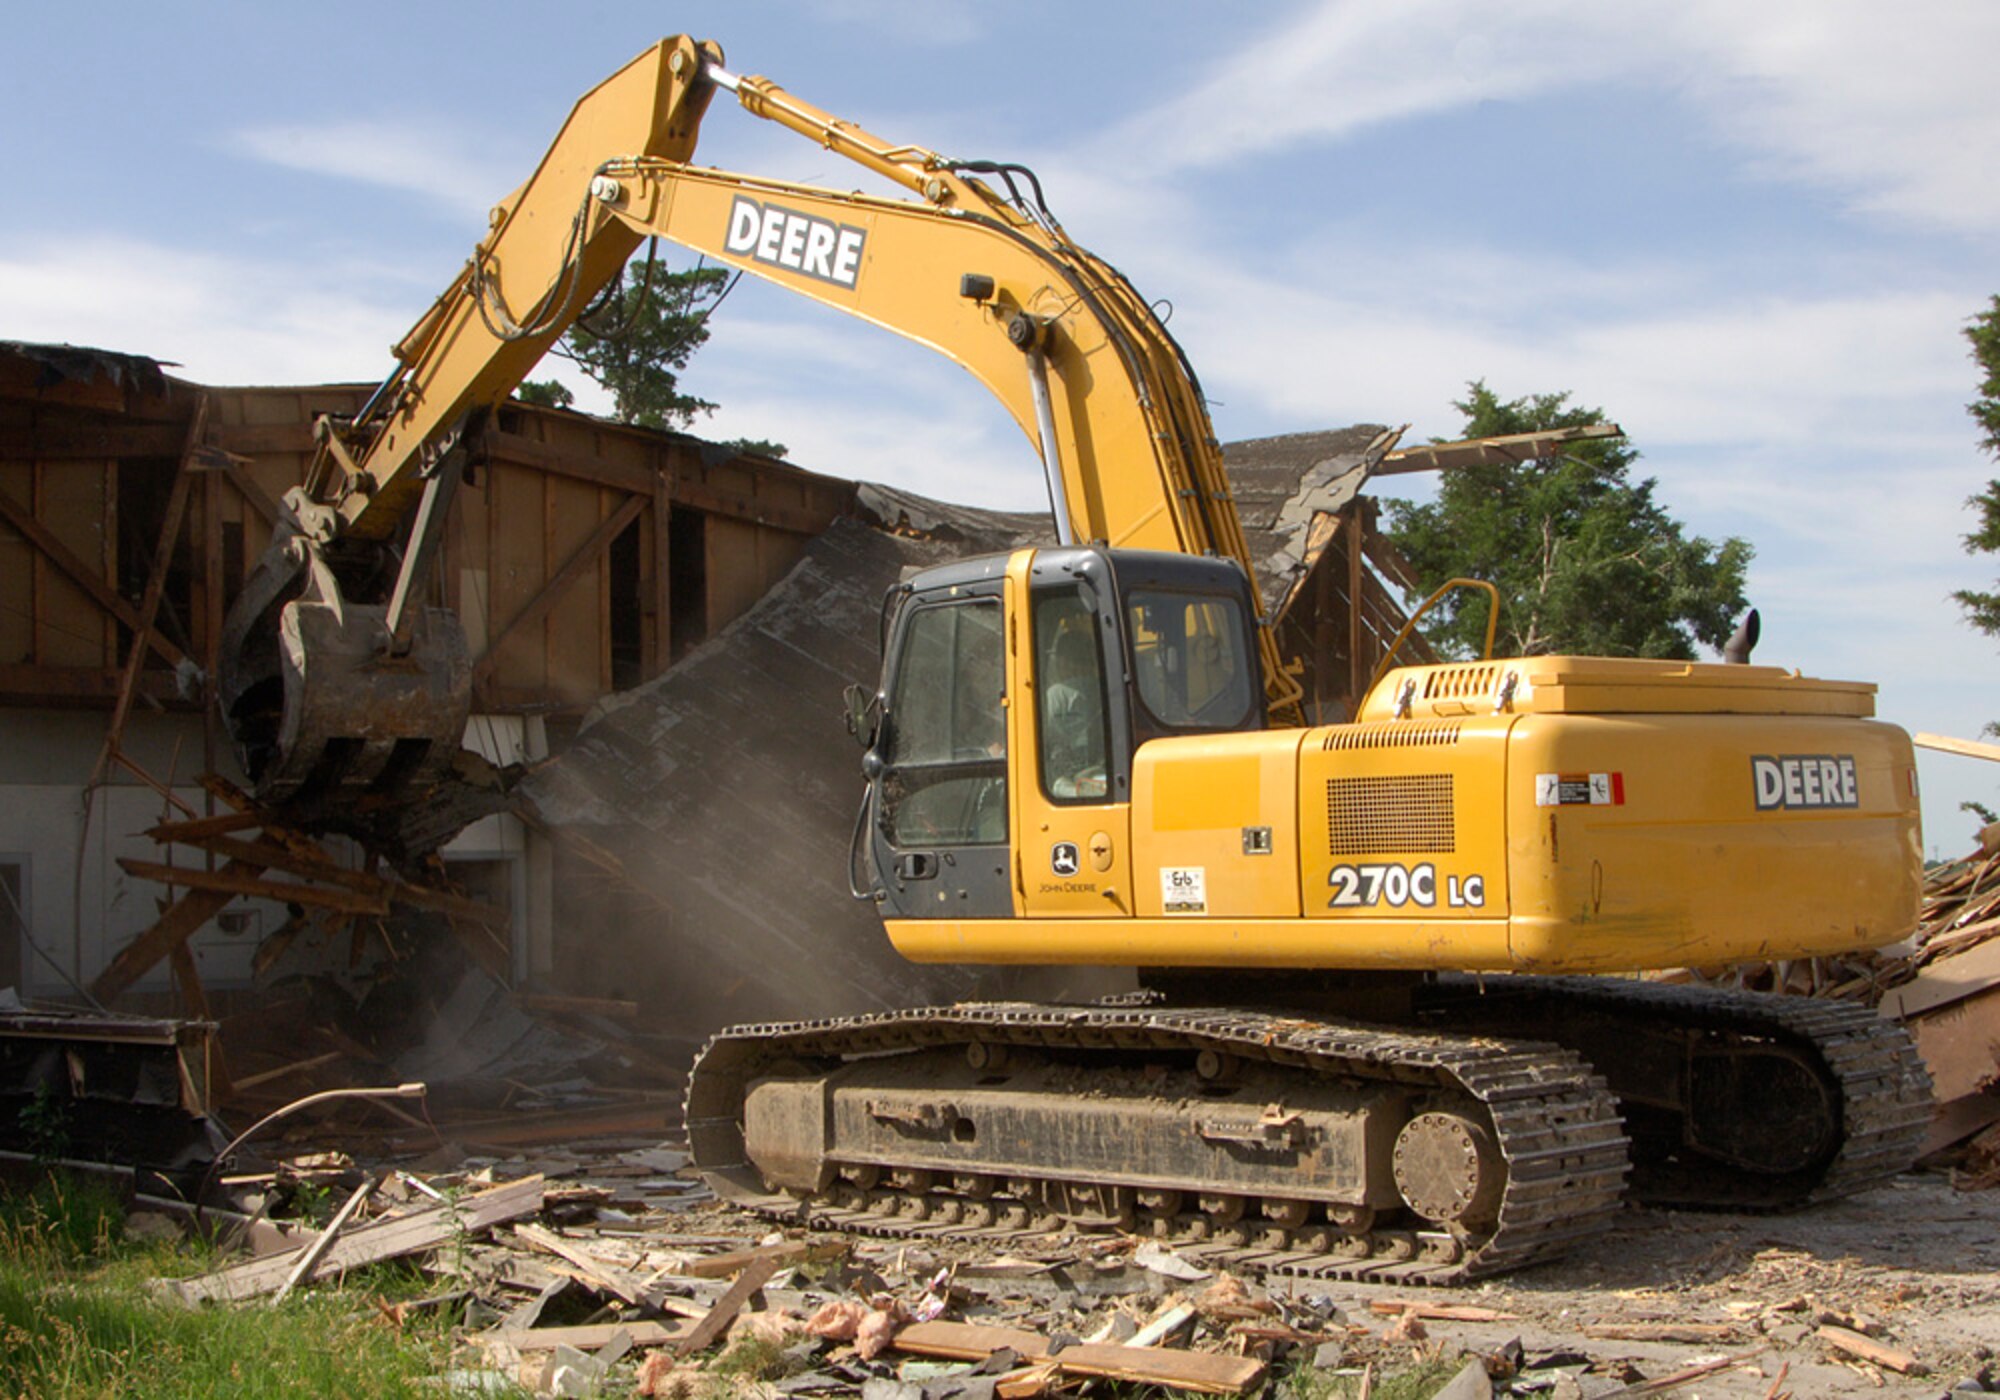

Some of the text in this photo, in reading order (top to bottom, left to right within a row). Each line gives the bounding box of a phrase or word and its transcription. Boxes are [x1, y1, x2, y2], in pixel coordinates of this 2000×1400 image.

[727, 200, 863, 285] DEERE
[1754, 759, 1857, 807] DEERE
[1039, 882, 1097, 893] JOHN DEERE
[1330, 865, 1484, 906] 270C LC
